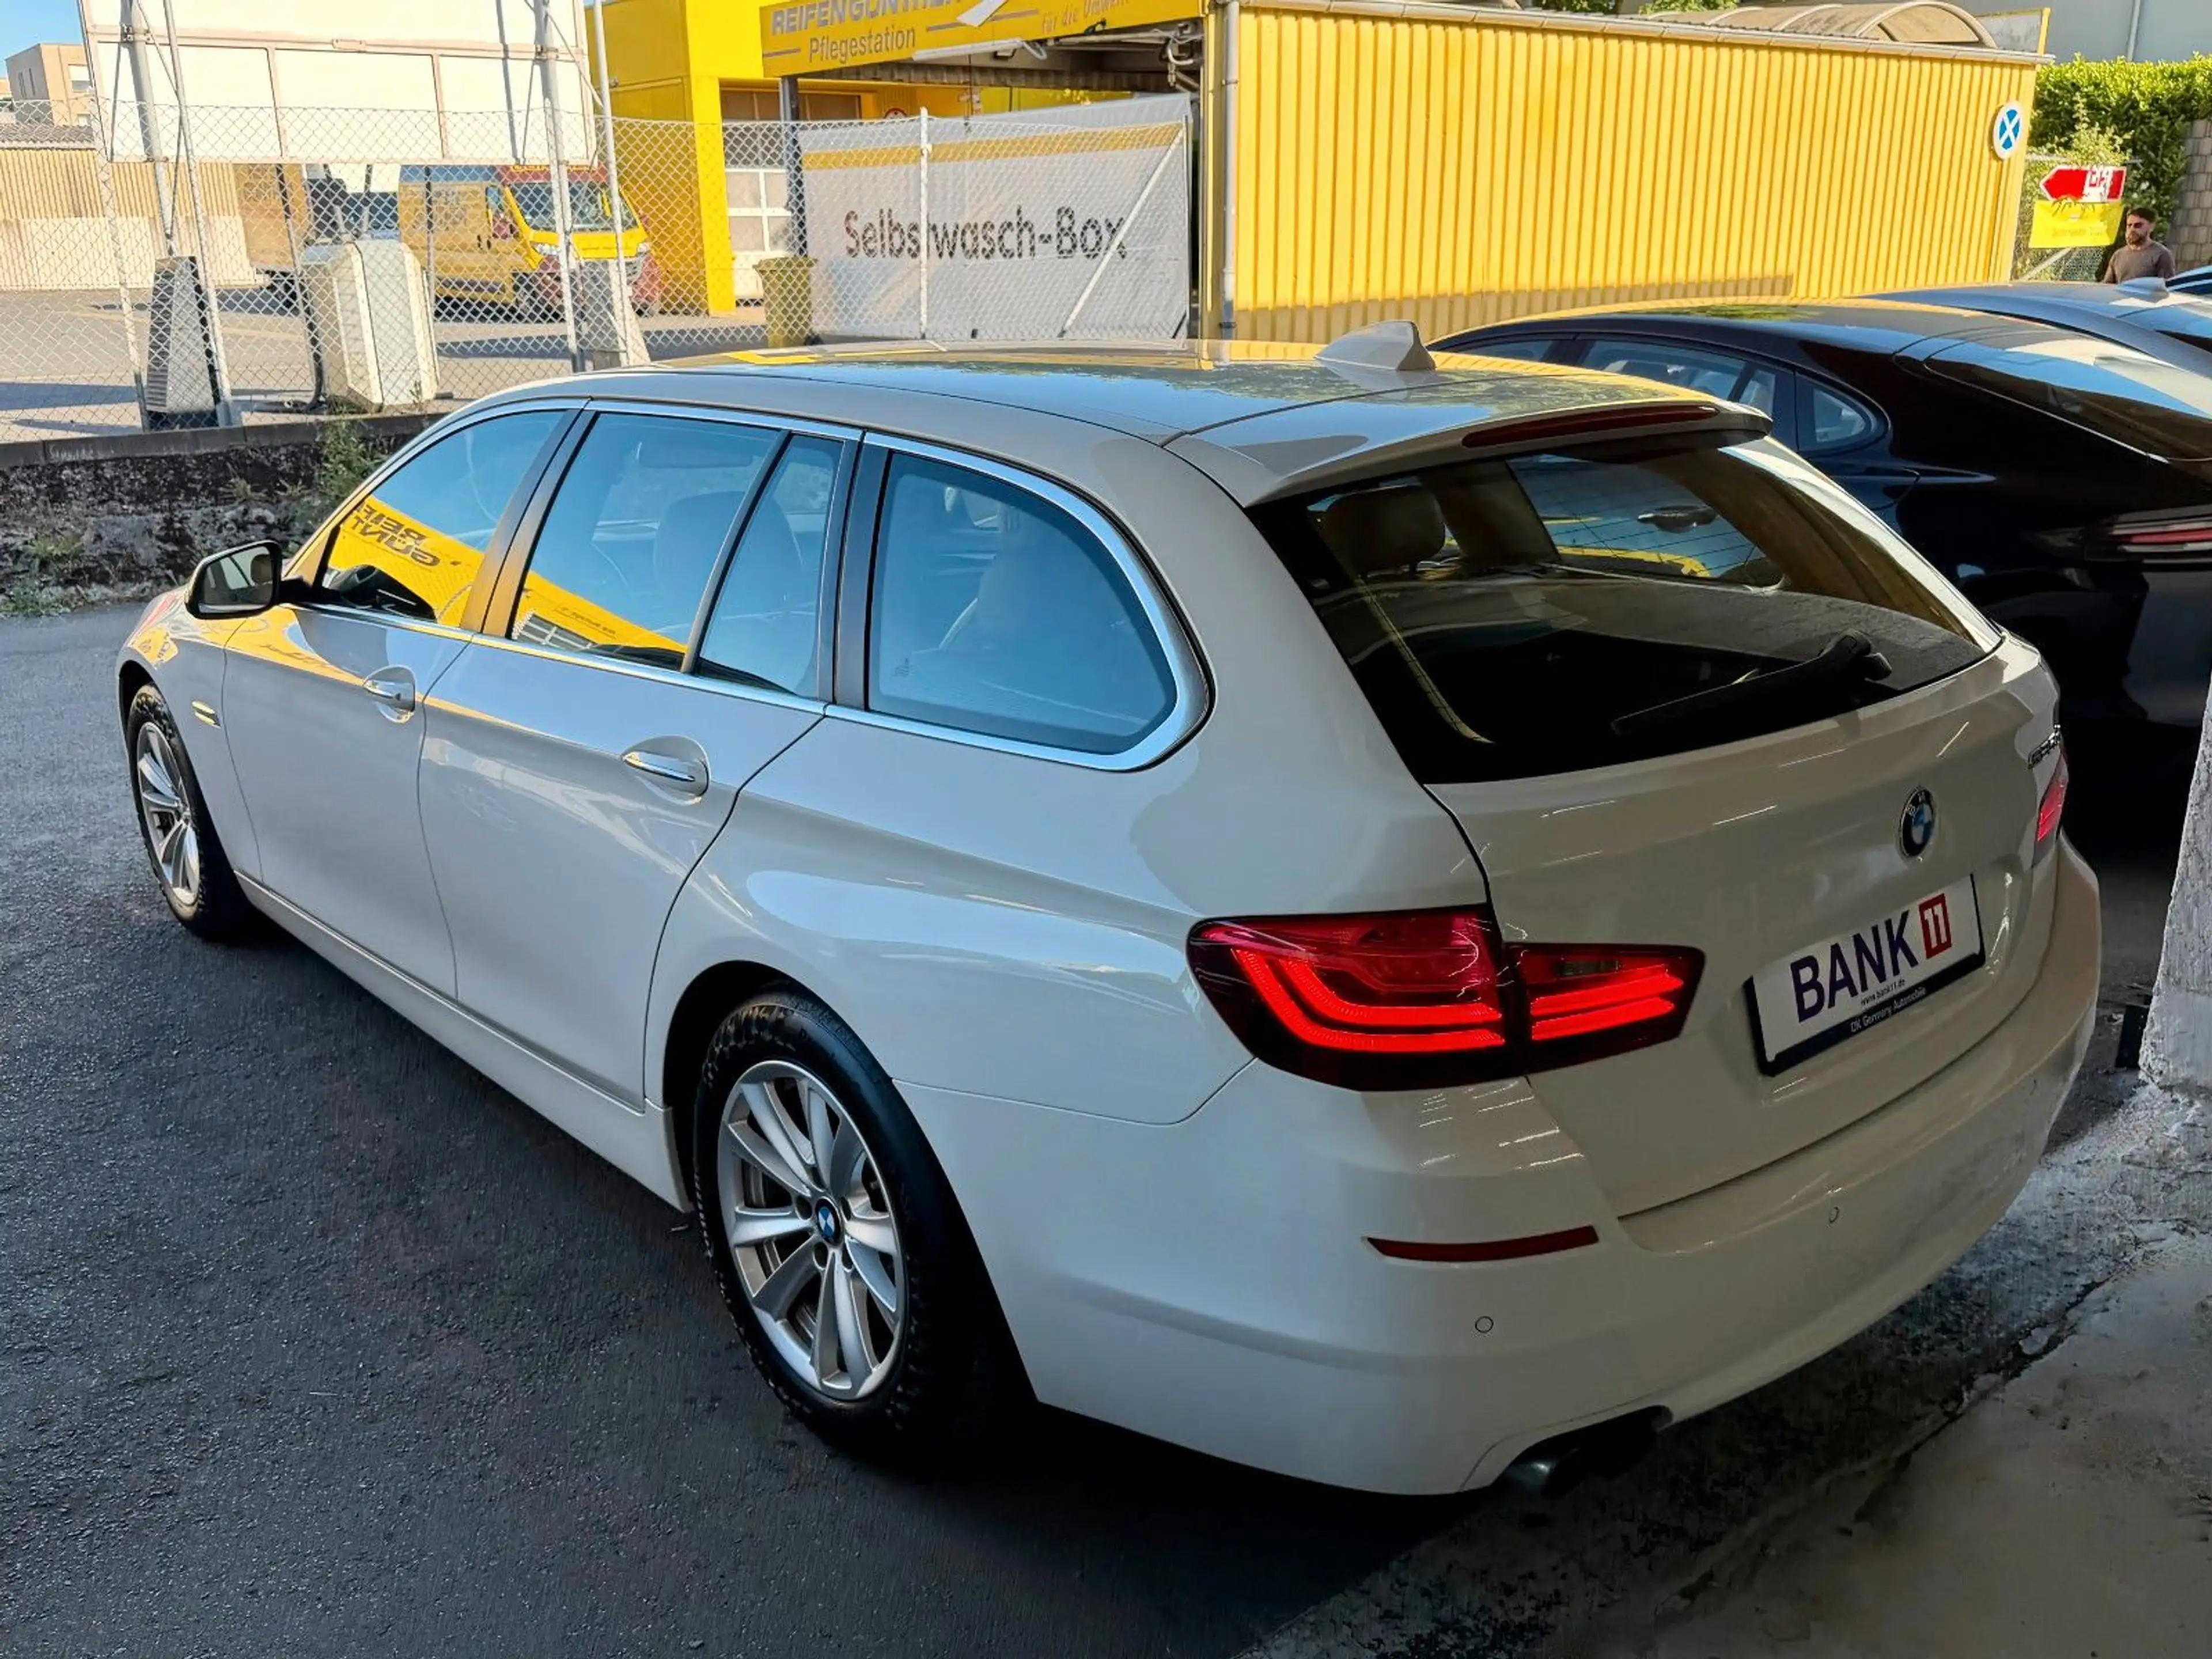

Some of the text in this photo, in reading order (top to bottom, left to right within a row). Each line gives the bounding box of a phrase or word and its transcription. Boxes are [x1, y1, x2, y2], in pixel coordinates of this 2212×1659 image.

[771, 0, 846, 36] REIFEN
[809, 25, 916, 63] Pflegestation
[1790, 910, 1919, 1023] BANK
